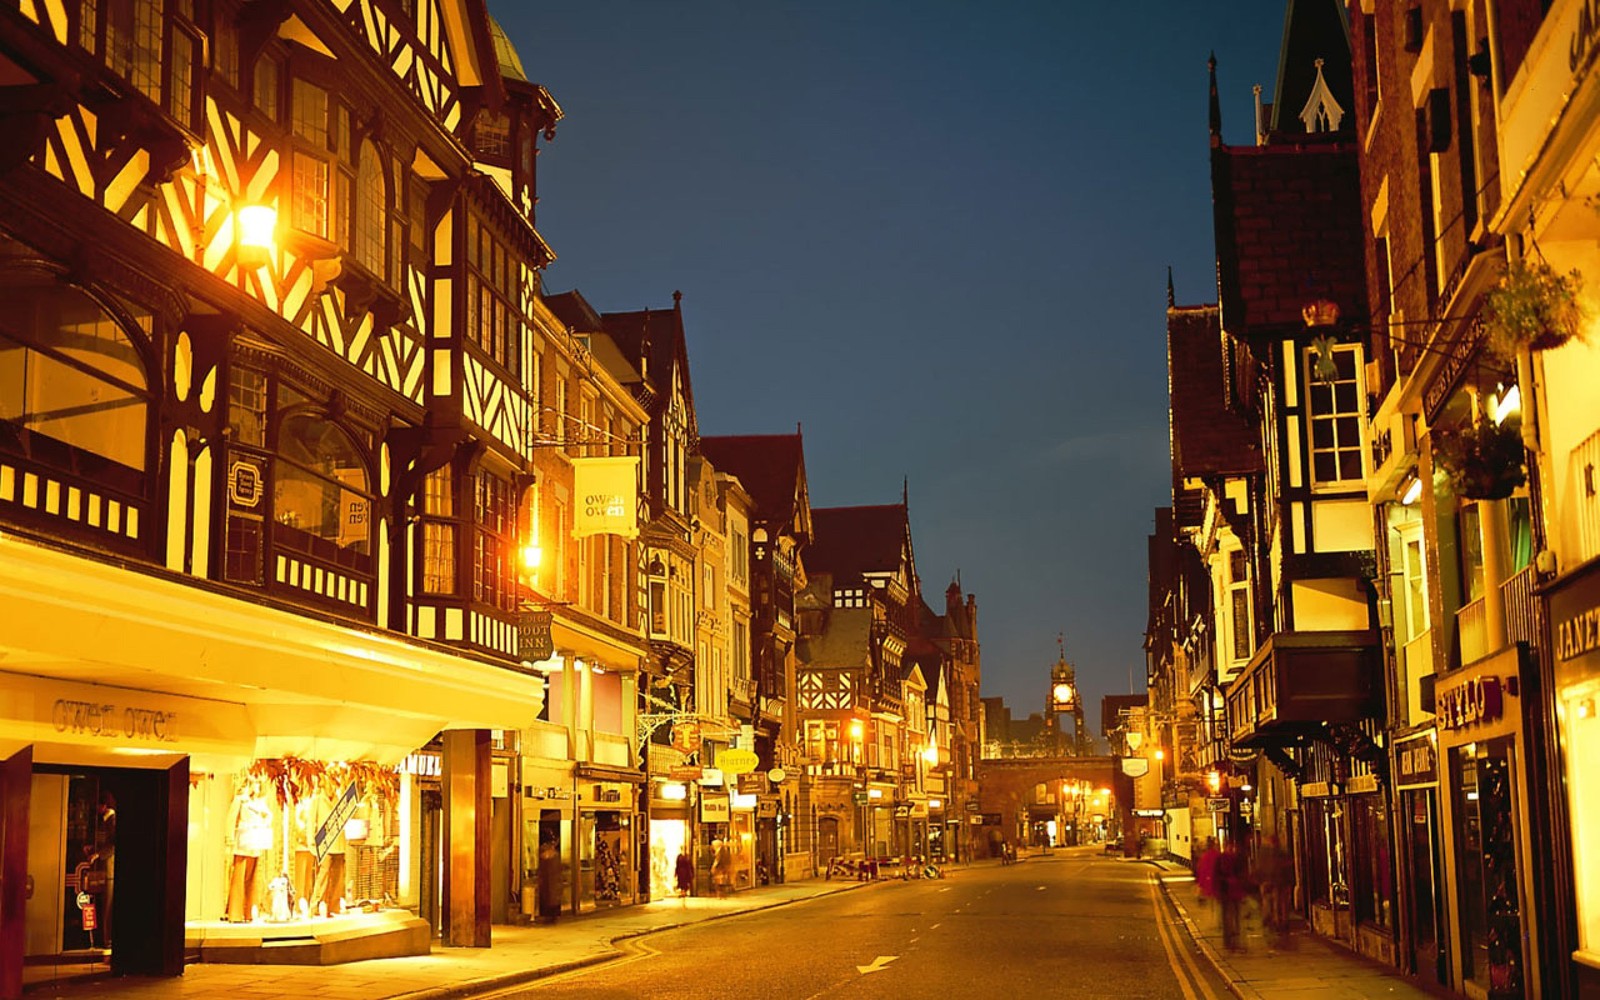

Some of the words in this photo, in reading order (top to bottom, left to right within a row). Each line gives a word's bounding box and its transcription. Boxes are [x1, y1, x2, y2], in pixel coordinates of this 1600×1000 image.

[585, 495, 625, 506] owen
[585, 506, 625, 517] owen
[1436, 676, 1486, 731] STYLO
[52, 699, 118, 738] owen
[124, 707, 179, 743] owen
